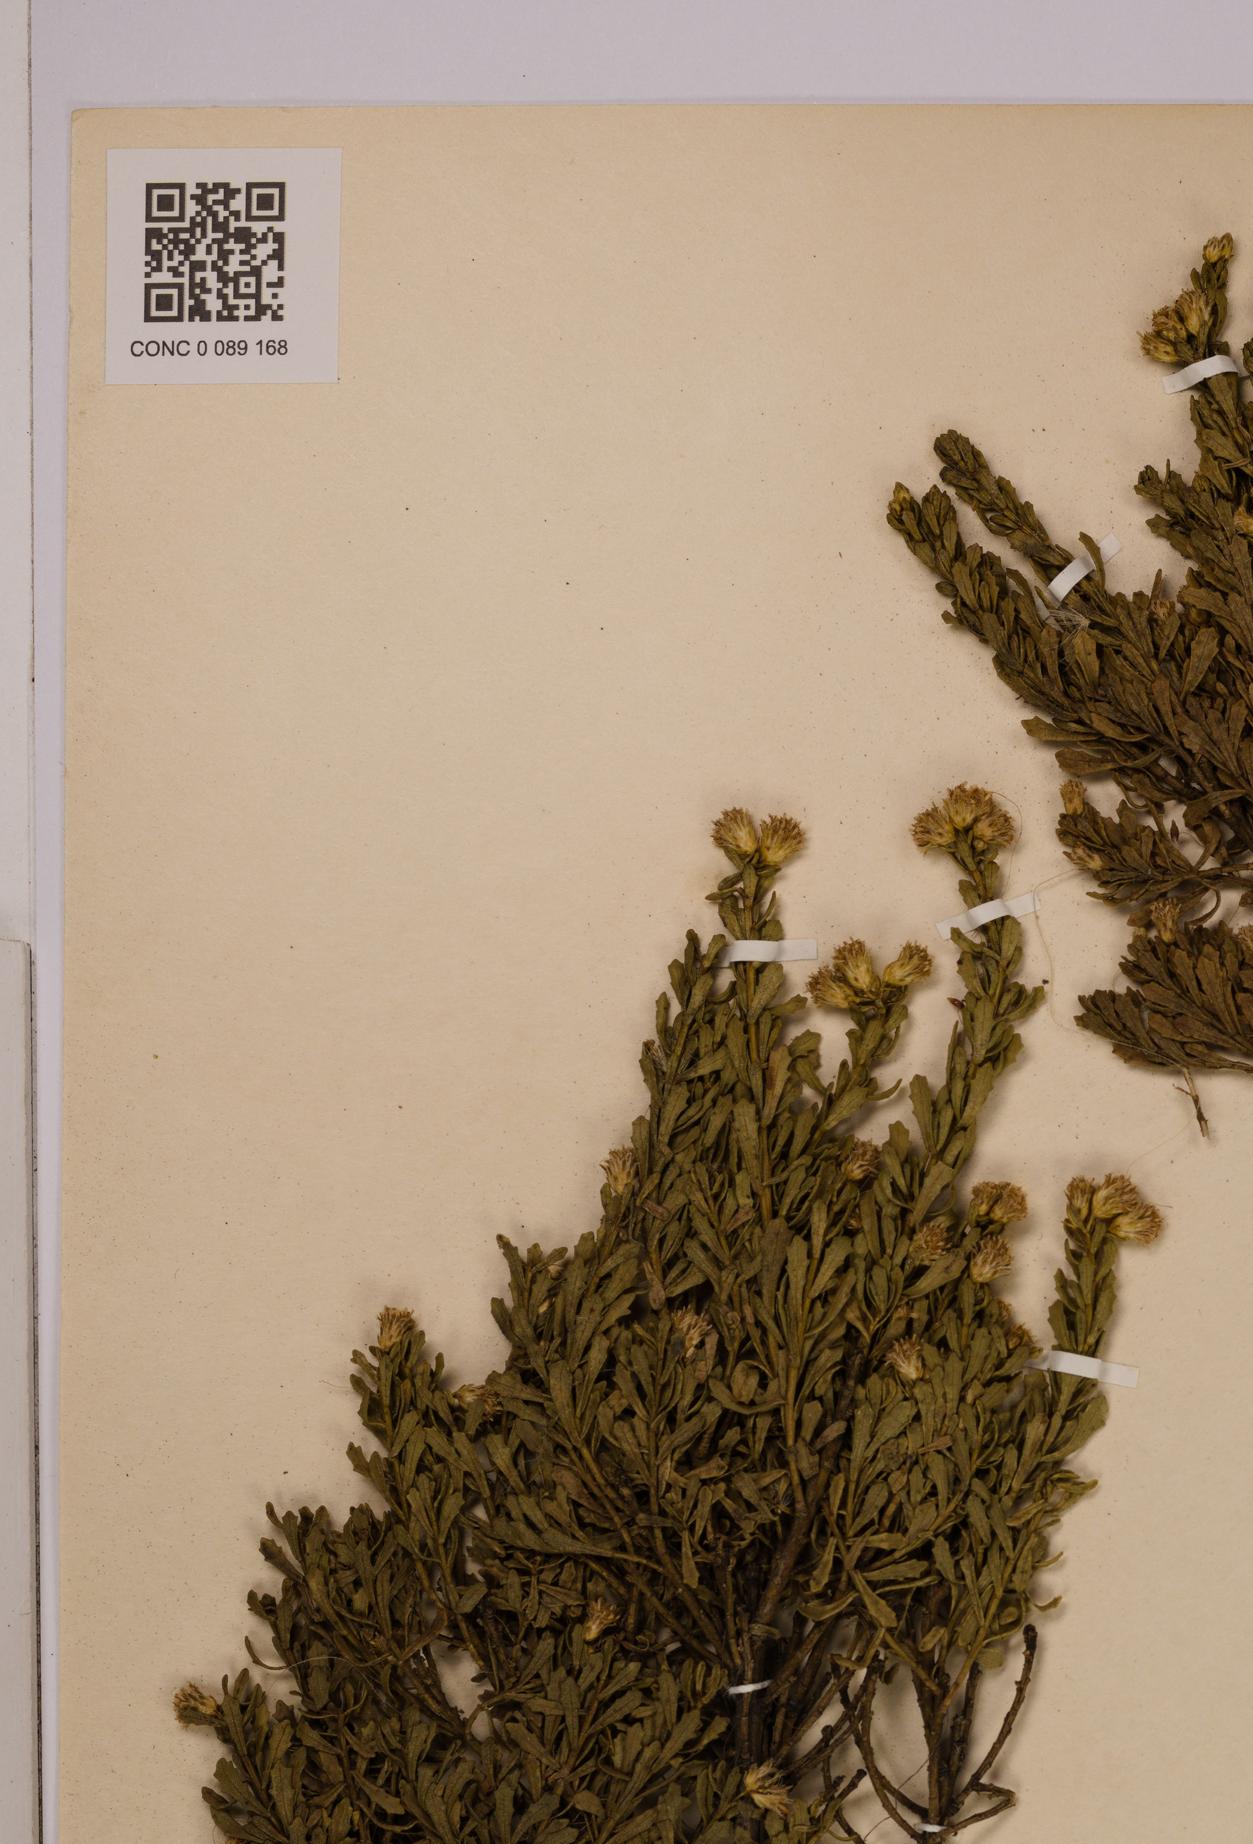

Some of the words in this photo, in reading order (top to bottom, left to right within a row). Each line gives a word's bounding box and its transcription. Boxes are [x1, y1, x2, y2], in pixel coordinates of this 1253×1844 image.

[130, 339, 191, 358] CONC
[196, 340, 208, 357] 0
[214, 339, 248, 357] 089
[255, 339, 288, 356] 168
